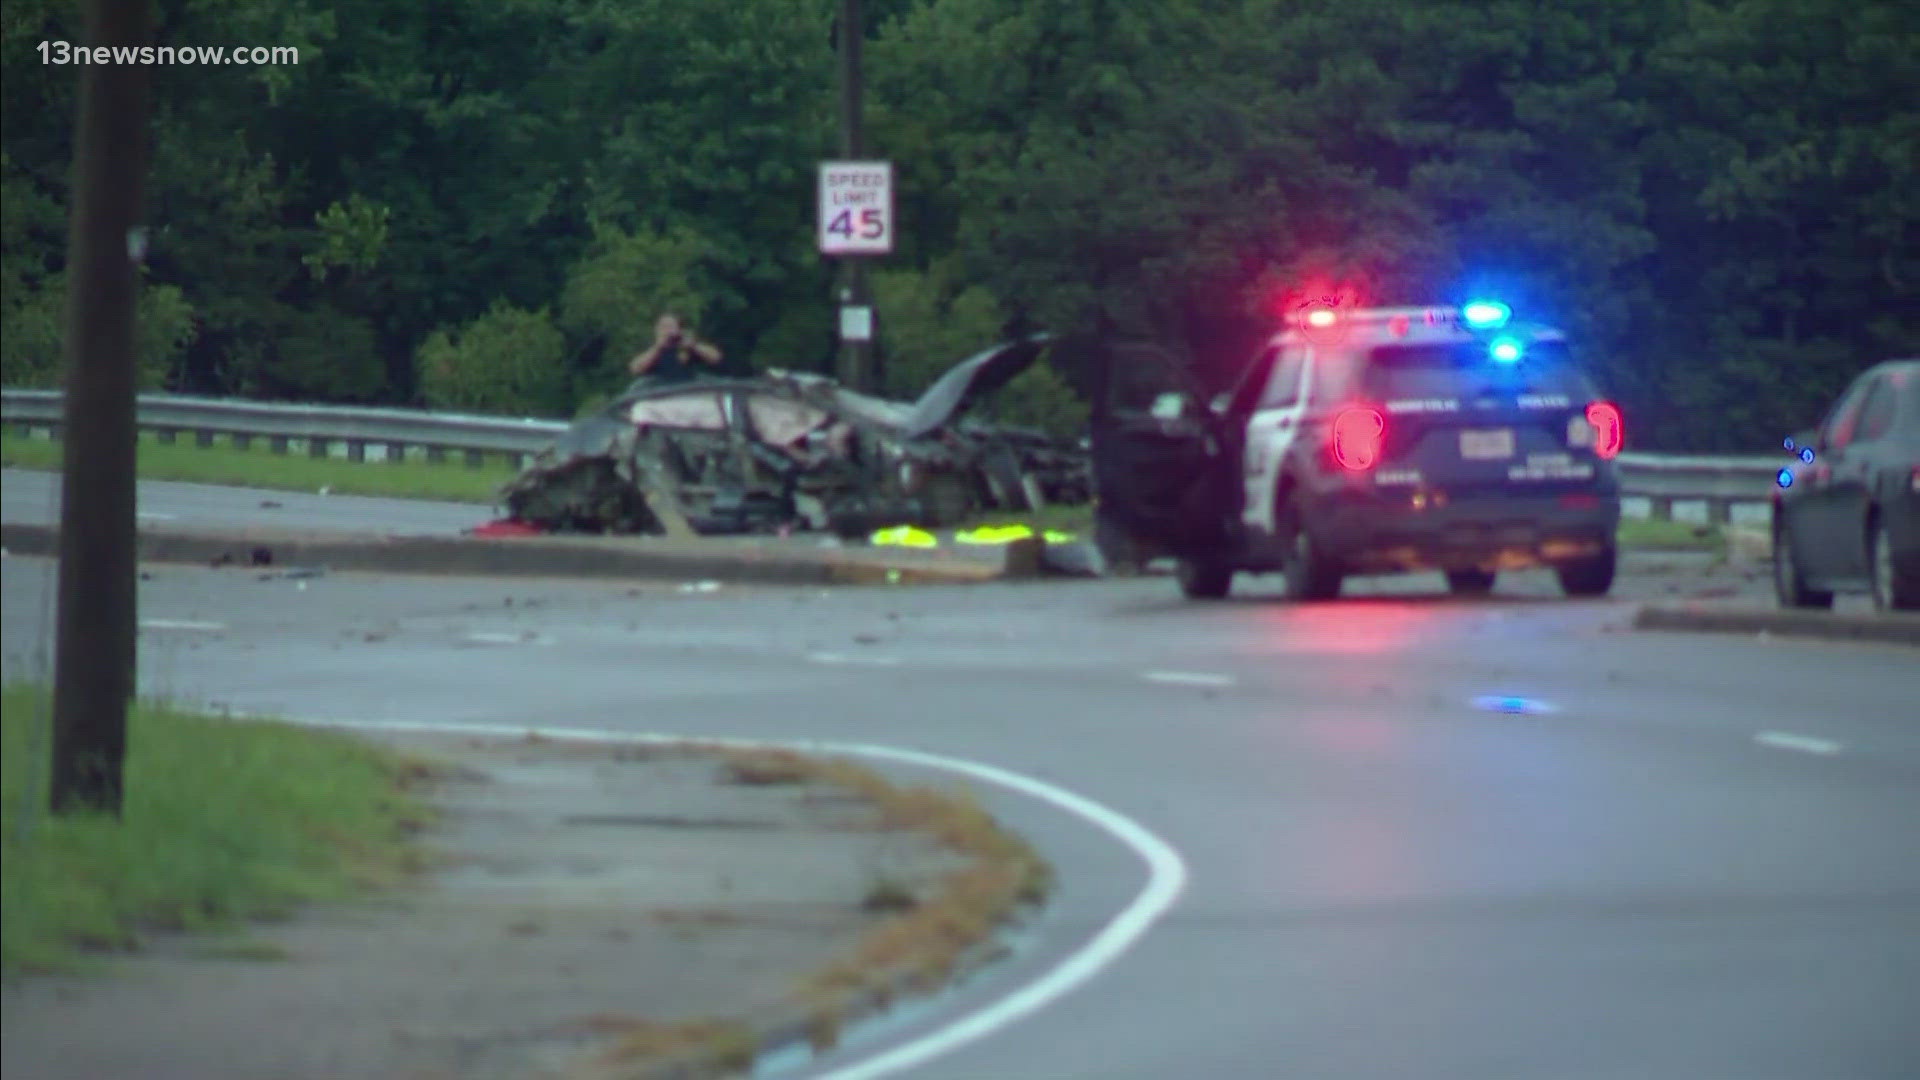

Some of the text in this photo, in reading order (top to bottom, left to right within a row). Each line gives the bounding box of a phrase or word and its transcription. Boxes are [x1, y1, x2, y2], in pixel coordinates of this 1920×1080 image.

[828, 173, 884, 187] SPEED
[833, 190, 878, 205] LIMIT
[827, 208, 884, 239] 45
